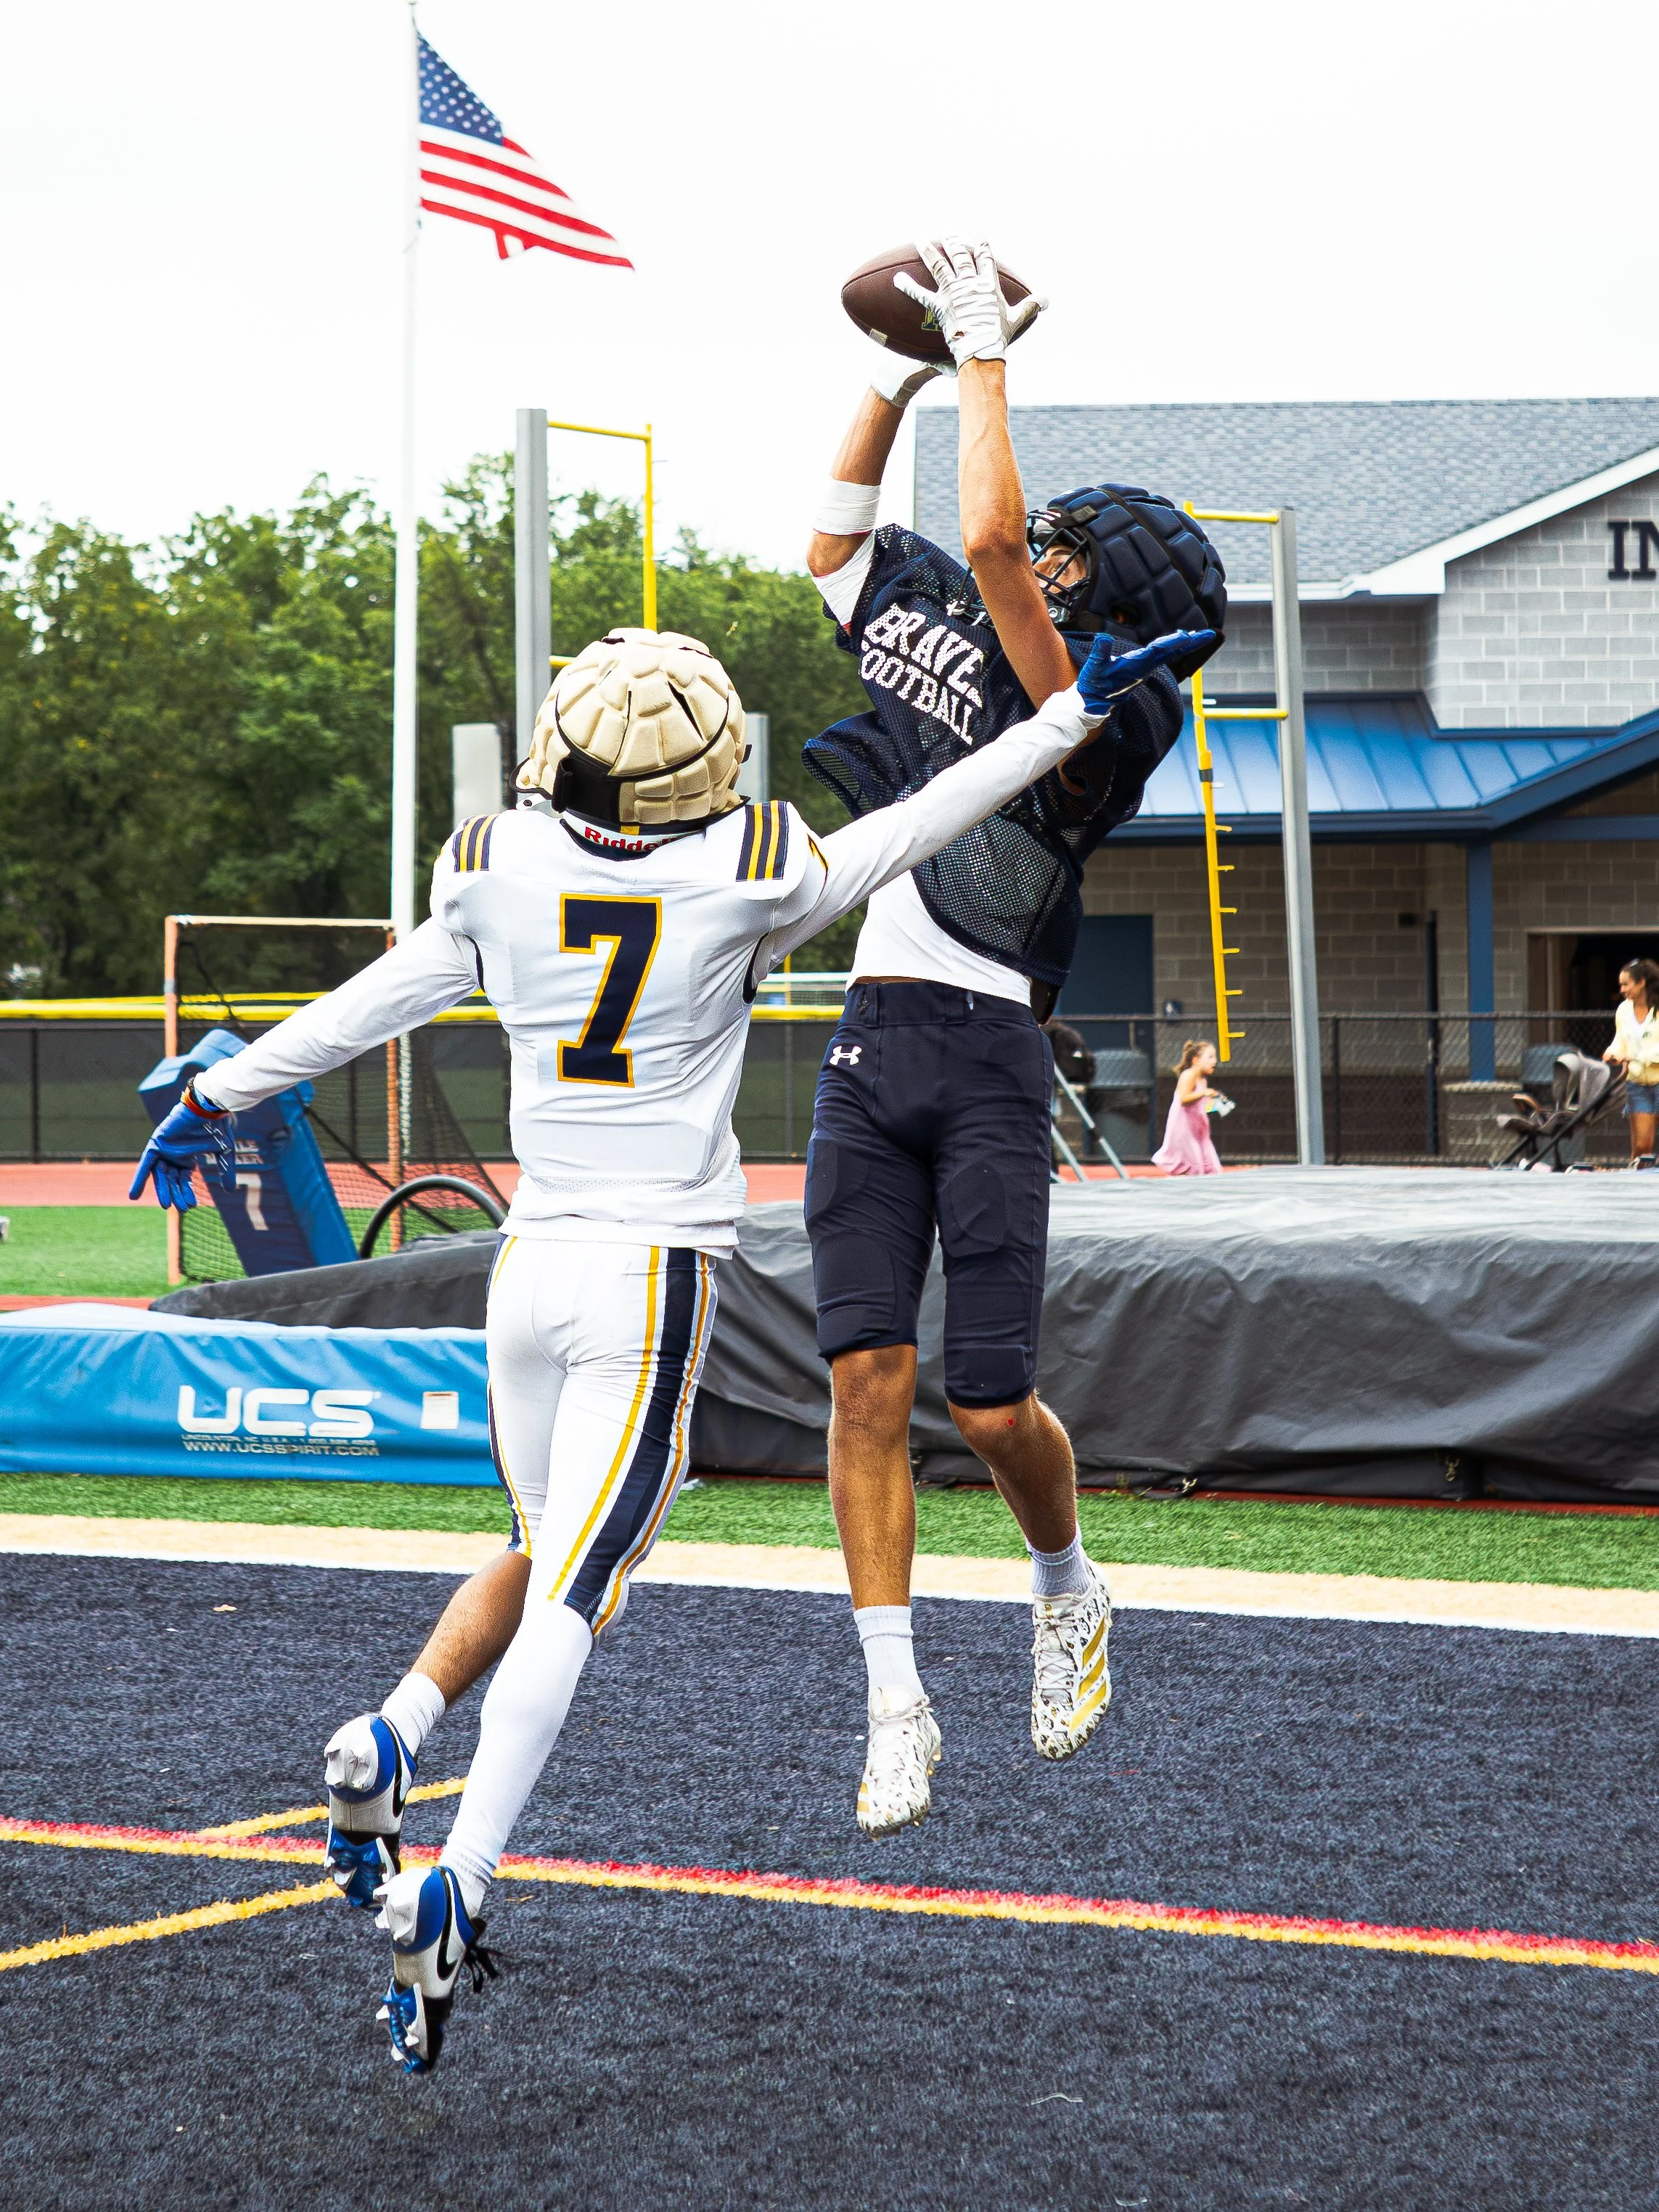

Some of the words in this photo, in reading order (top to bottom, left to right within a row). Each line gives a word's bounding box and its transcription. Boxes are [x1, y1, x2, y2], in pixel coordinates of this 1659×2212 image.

[861, 639, 973, 746] OOTBALL
[558, 893, 662, 1088] 7
[177, 1385, 374, 1437] UCS
[182, 1441, 380, 1457] WWW.UCSSPIRIT.COM
